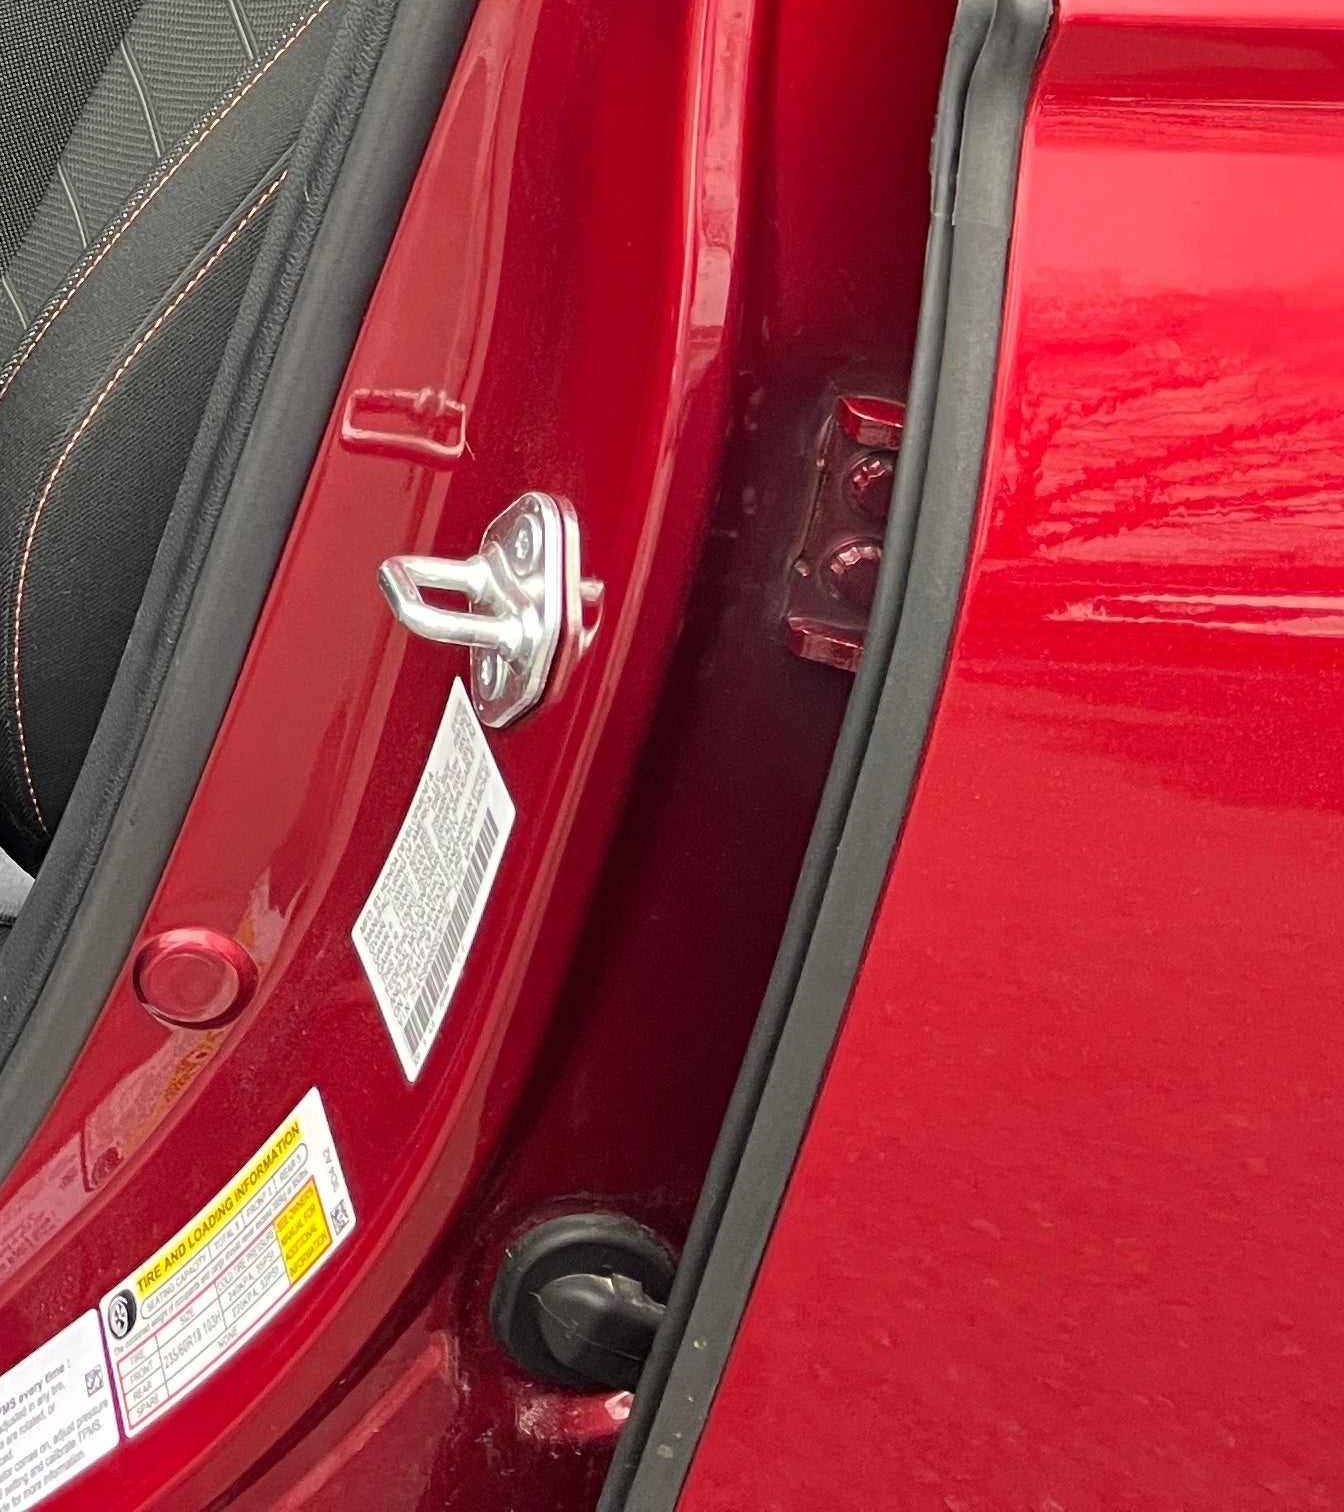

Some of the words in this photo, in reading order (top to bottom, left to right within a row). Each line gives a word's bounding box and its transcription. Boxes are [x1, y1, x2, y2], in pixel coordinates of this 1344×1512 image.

[137, 1263, 162, 1293] TIRE
[162, 1242, 186, 1271] AND
[187, 1196, 233, 1248] LOADING
[233, 1122, 299, 1202] INFORMATION
[18, 1379, 43, 1405] every
